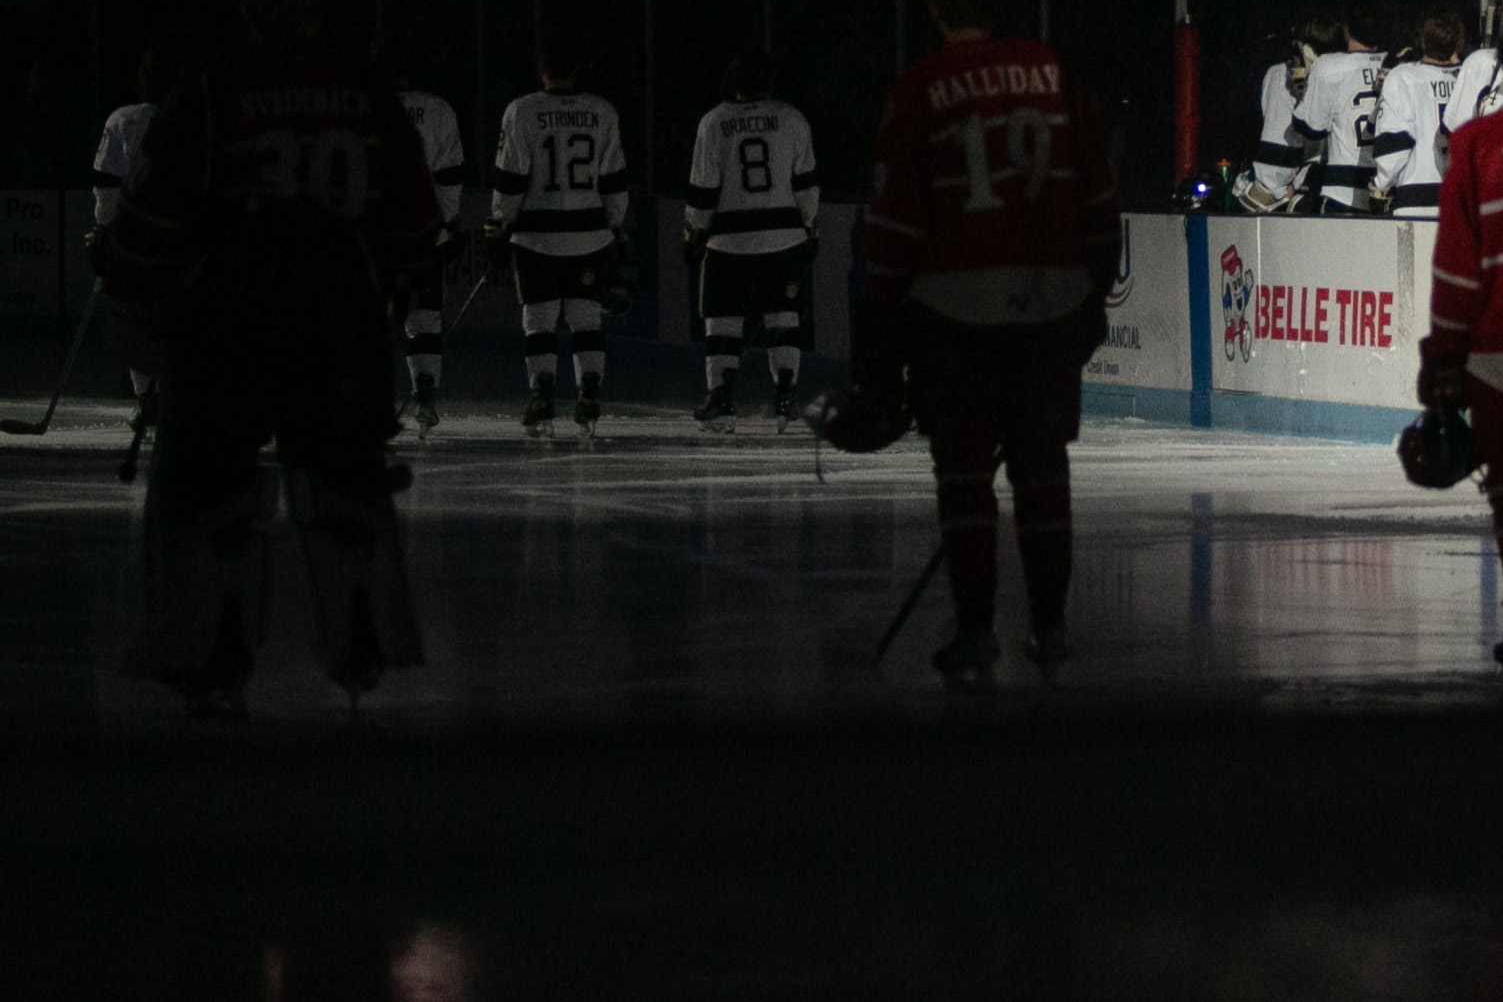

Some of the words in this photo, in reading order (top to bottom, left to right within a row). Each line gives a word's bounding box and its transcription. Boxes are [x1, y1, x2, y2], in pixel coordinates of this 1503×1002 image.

[926, 63, 1062, 110] HALLIDAY
[537, 110, 599, 130] STRINDEN
[721, 115, 779, 138] BRACCINI
[543, 134, 597, 191] 12
[739, 137, 773, 193] 8
[954, 106, 1053, 214] 19
[1255, 284, 1329, 343] BELLE
[1336, 289, 1393, 348] TIRE
